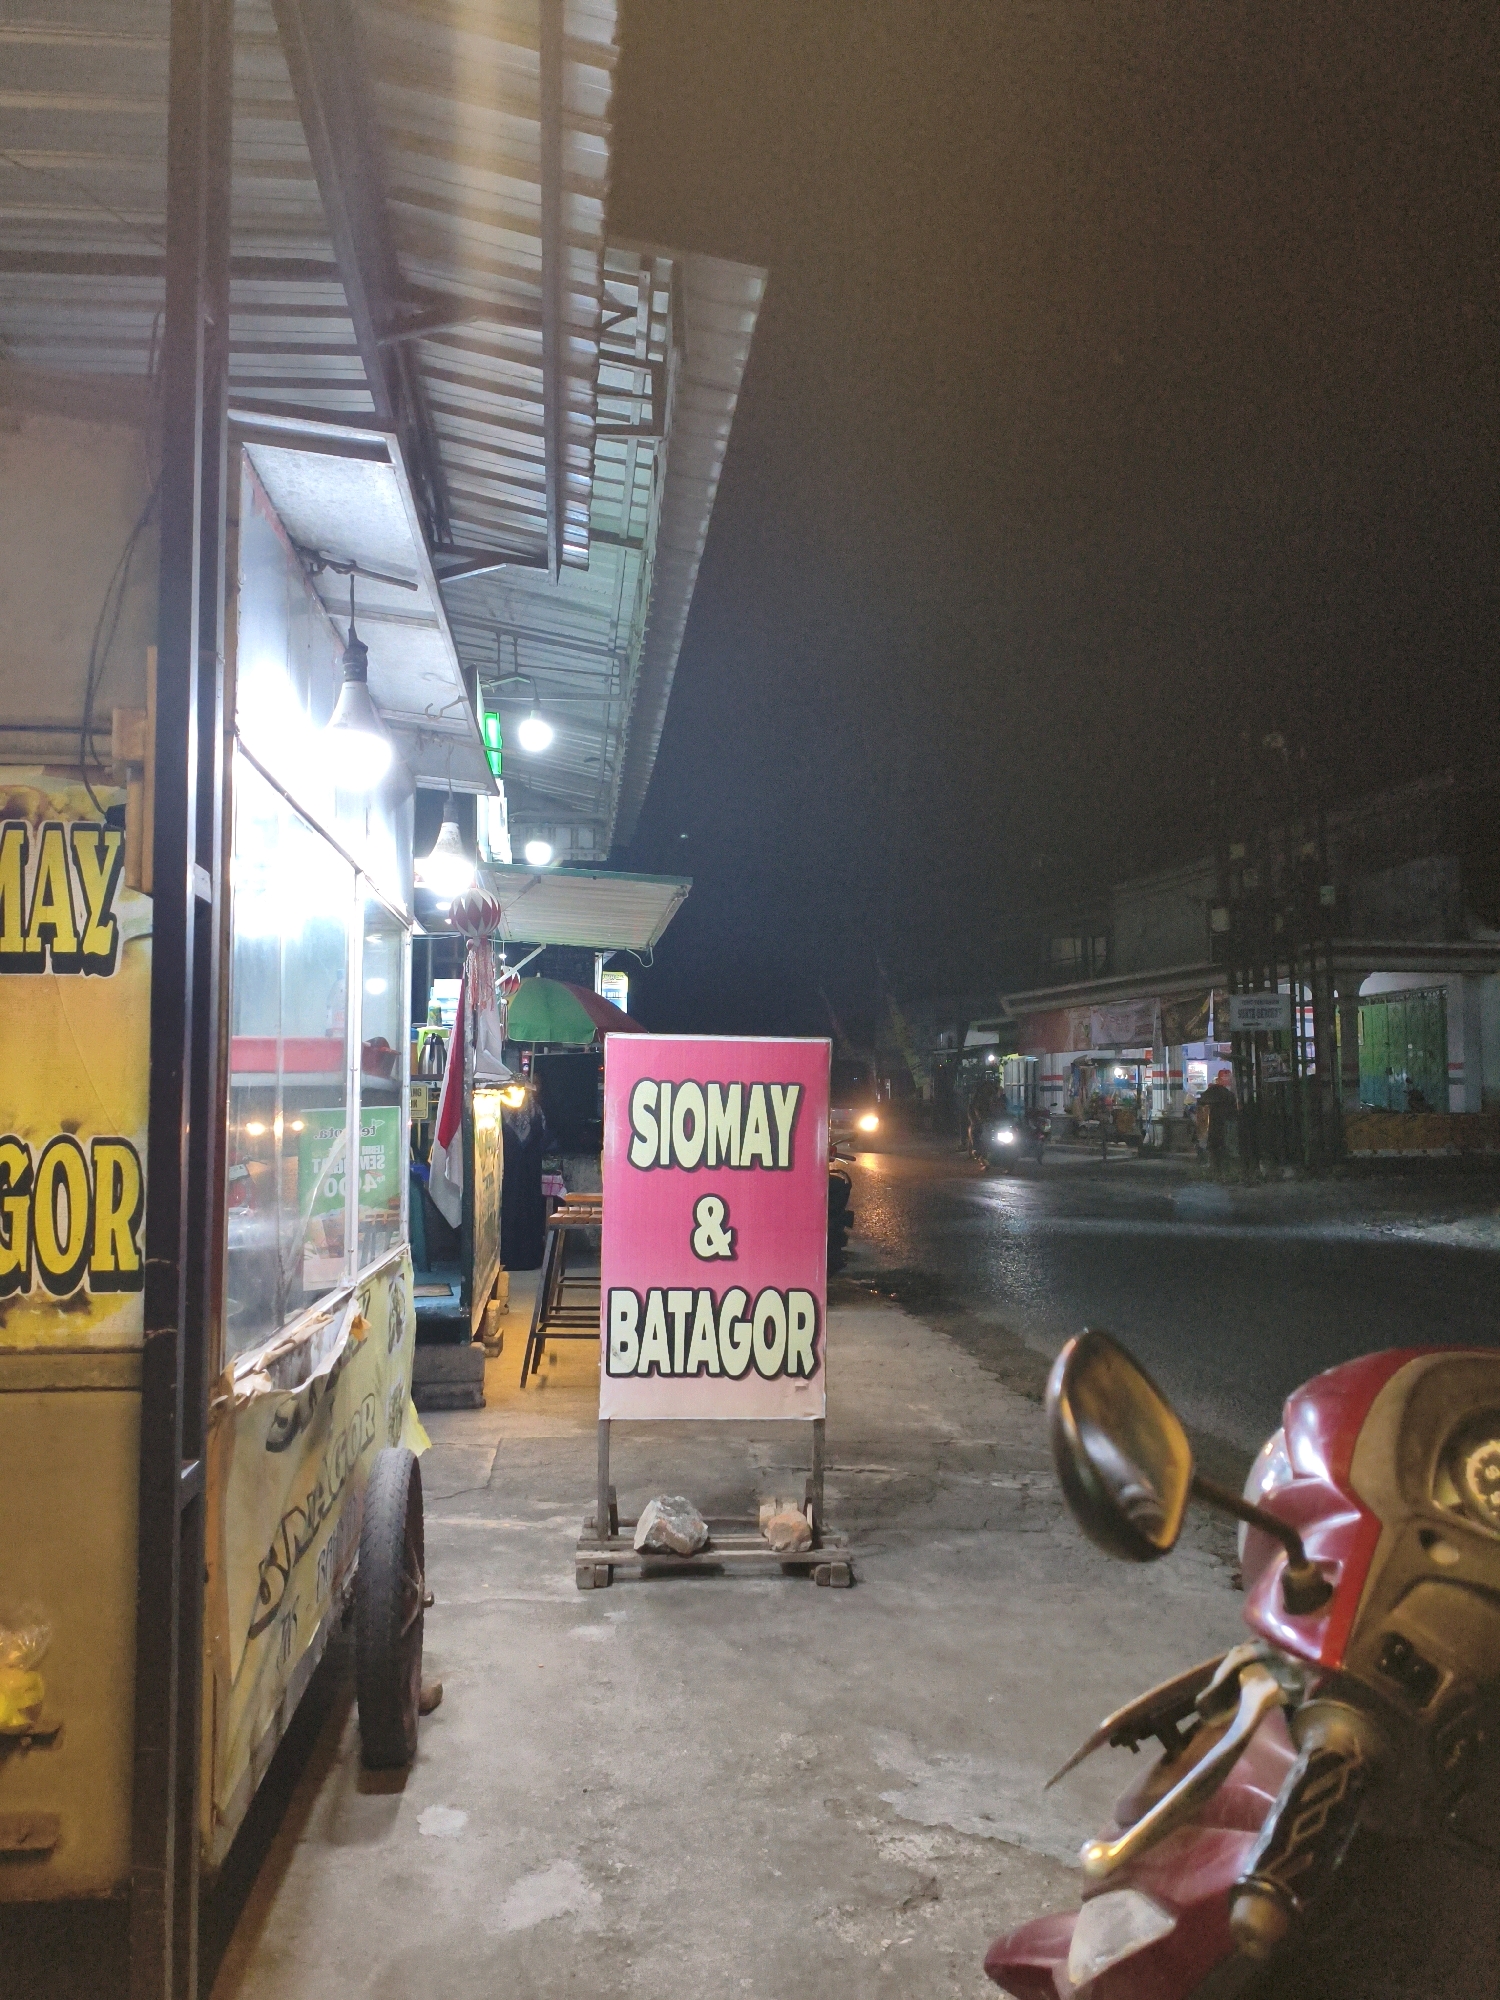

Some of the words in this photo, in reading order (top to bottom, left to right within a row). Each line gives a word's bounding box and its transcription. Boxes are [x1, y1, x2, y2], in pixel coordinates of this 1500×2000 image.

[628, 1078, 804, 1172] SIOMAY
[690, 1193, 737, 1261] &
[607, 1286, 819, 1380] BATAGOR
